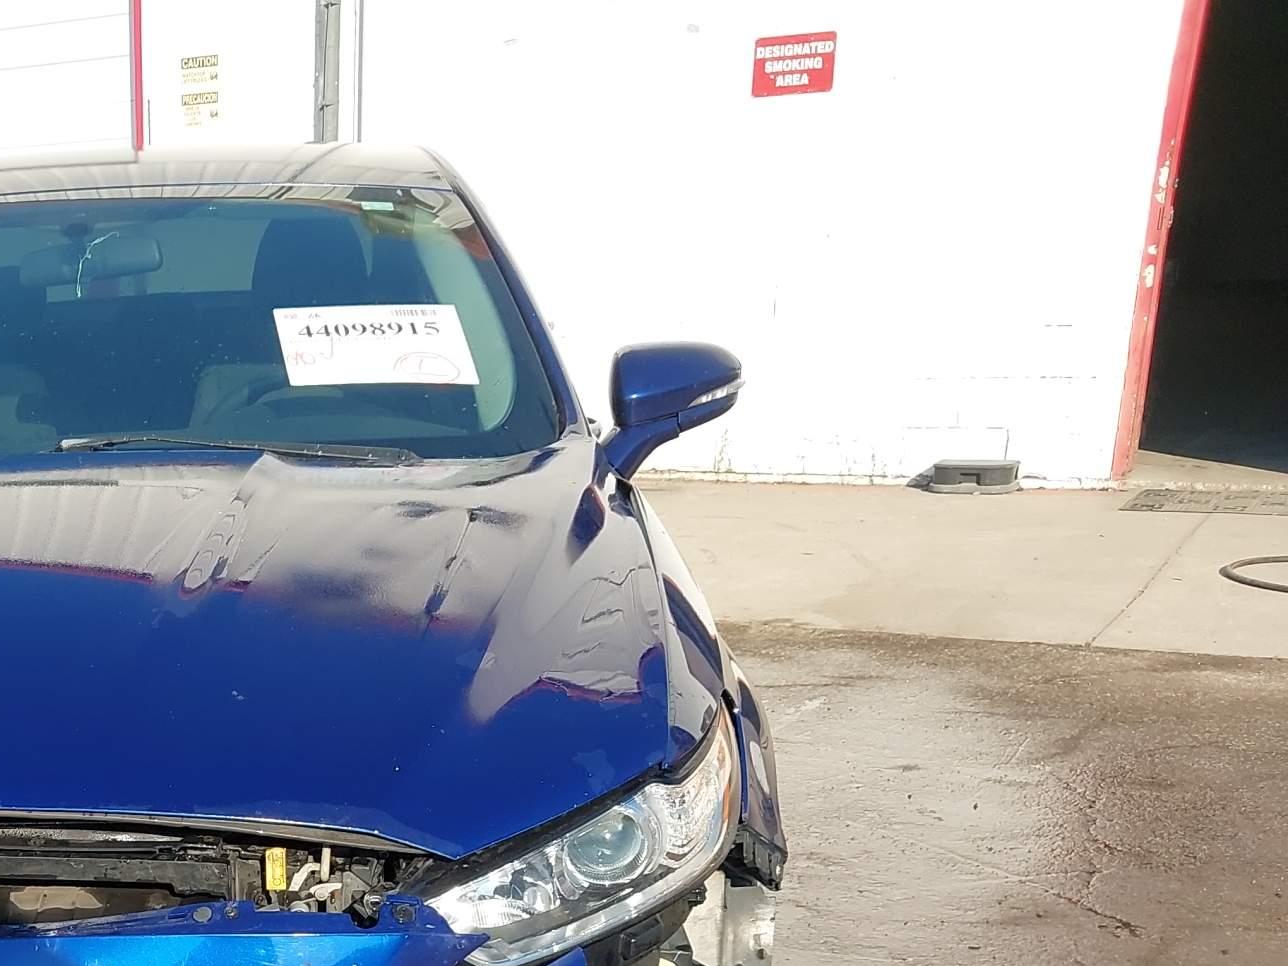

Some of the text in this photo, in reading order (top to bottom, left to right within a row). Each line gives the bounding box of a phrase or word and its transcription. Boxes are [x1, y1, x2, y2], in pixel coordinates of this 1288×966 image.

[756, 41, 834, 59] DESIGNATED
[183, 56, 217, 68] CAUTION
[765, 57, 822, 73] SMOKING
[775, 73, 809, 87] AREA
[298, 321, 440, 338] 44098915
